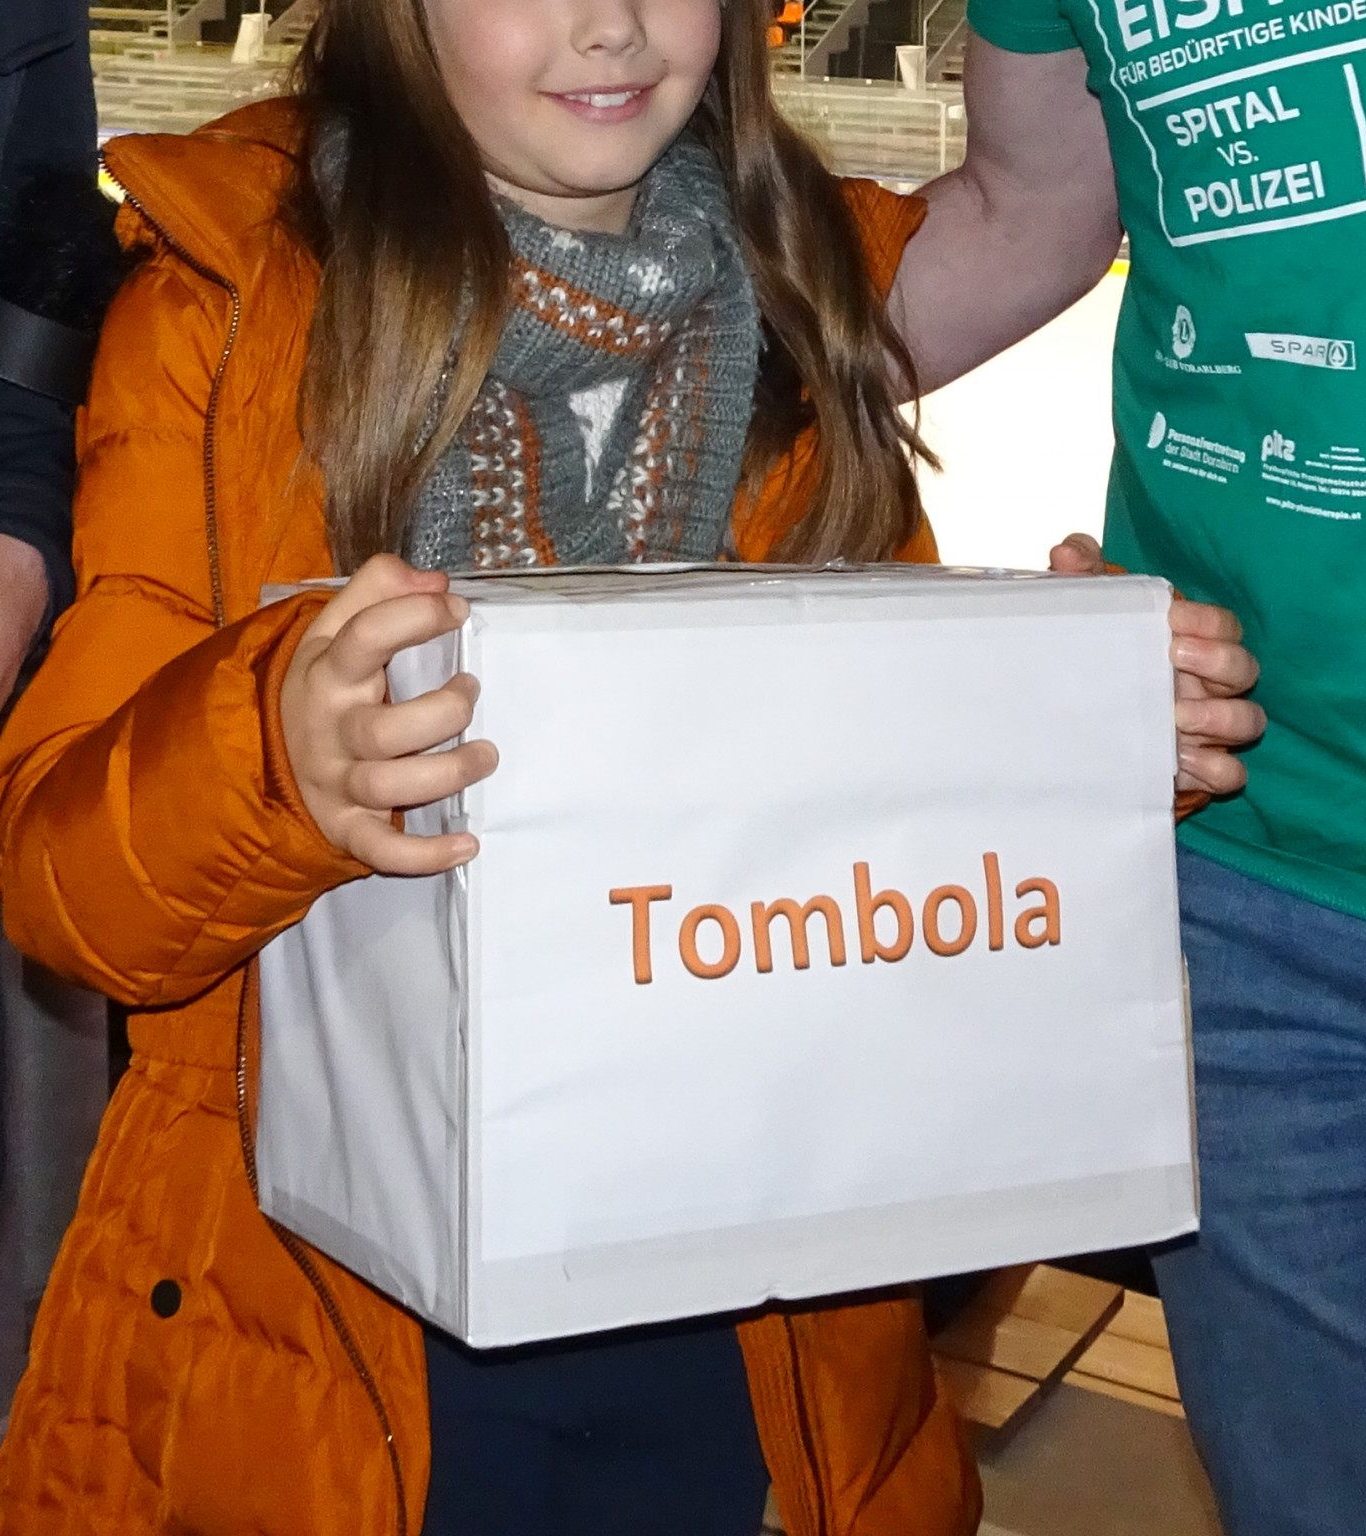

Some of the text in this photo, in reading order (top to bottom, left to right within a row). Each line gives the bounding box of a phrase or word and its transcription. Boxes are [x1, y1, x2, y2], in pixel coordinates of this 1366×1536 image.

[1119, 59, 1148, 86] FÜR
[1150, 21, 1286, 78] BEDÜRFTIGE
[1166, 86, 1300, 146] SPITAL
[1216, 141, 1259, 167] VS.
[1184, 161, 1325, 223] POLIZEI
[1271, 339, 1327, 360] SPAR
[609, 851, 1061, 985] Tombola
